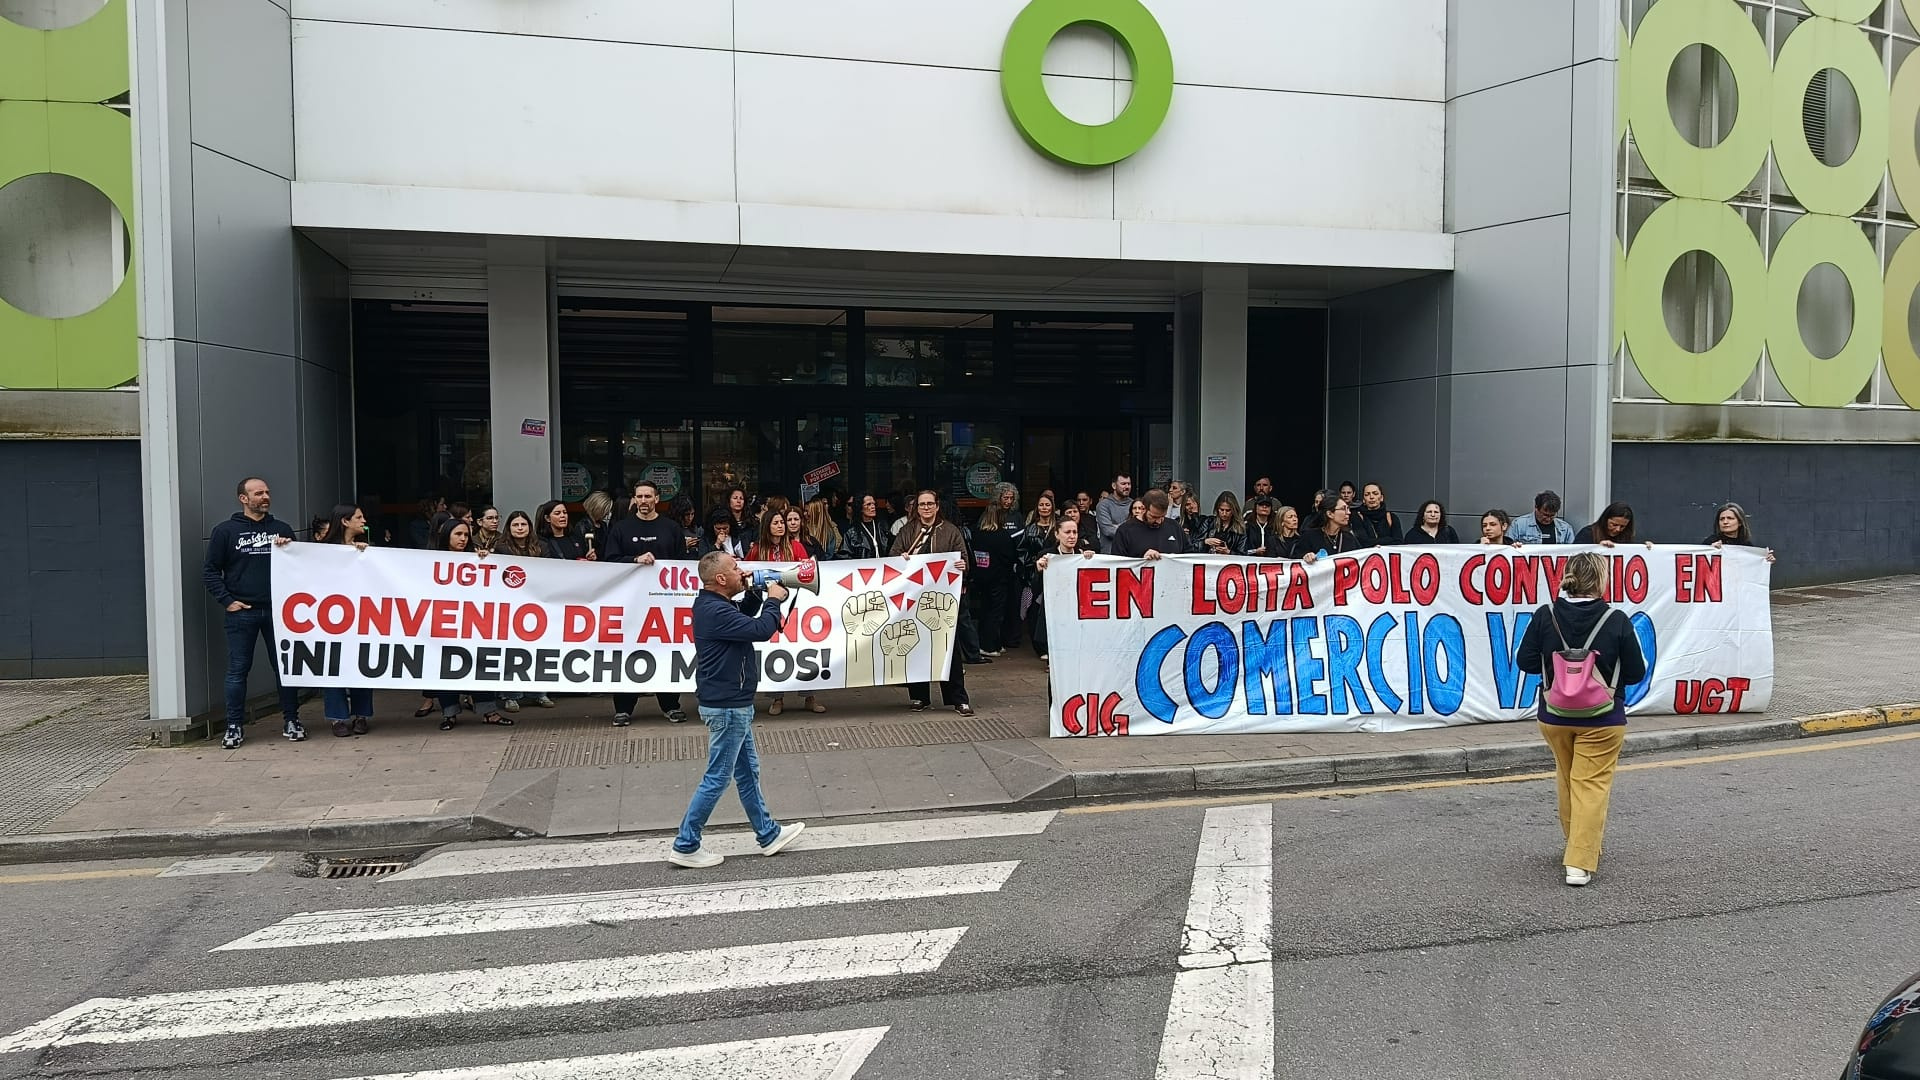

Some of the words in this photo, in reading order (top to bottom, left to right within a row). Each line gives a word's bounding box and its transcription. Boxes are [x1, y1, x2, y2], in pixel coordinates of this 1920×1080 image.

[433, 561, 497, 587] UGT
[659, 567, 699, 591] CIG
[1077, 566, 1155, 620] EN
[1192, 563, 1314, 615] LOITA
[1334, 552, 1440, 606] POLO
[1459, 553, 1649, 606] CONVIO
[1675, 553, 1723, 603] EN
[282, 592, 548, 642] CONVENIO
[563, 605, 624, 643] DE
[358, 643, 425, 679] UN
[440, 645, 657, 683] DERECHO
[671, 648, 832, 683] MOS!
[1135, 611, 1466, 725] COMERCIO
[1062, 691, 1129, 736] CIG
[1674, 678, 1750, 714] UGT
